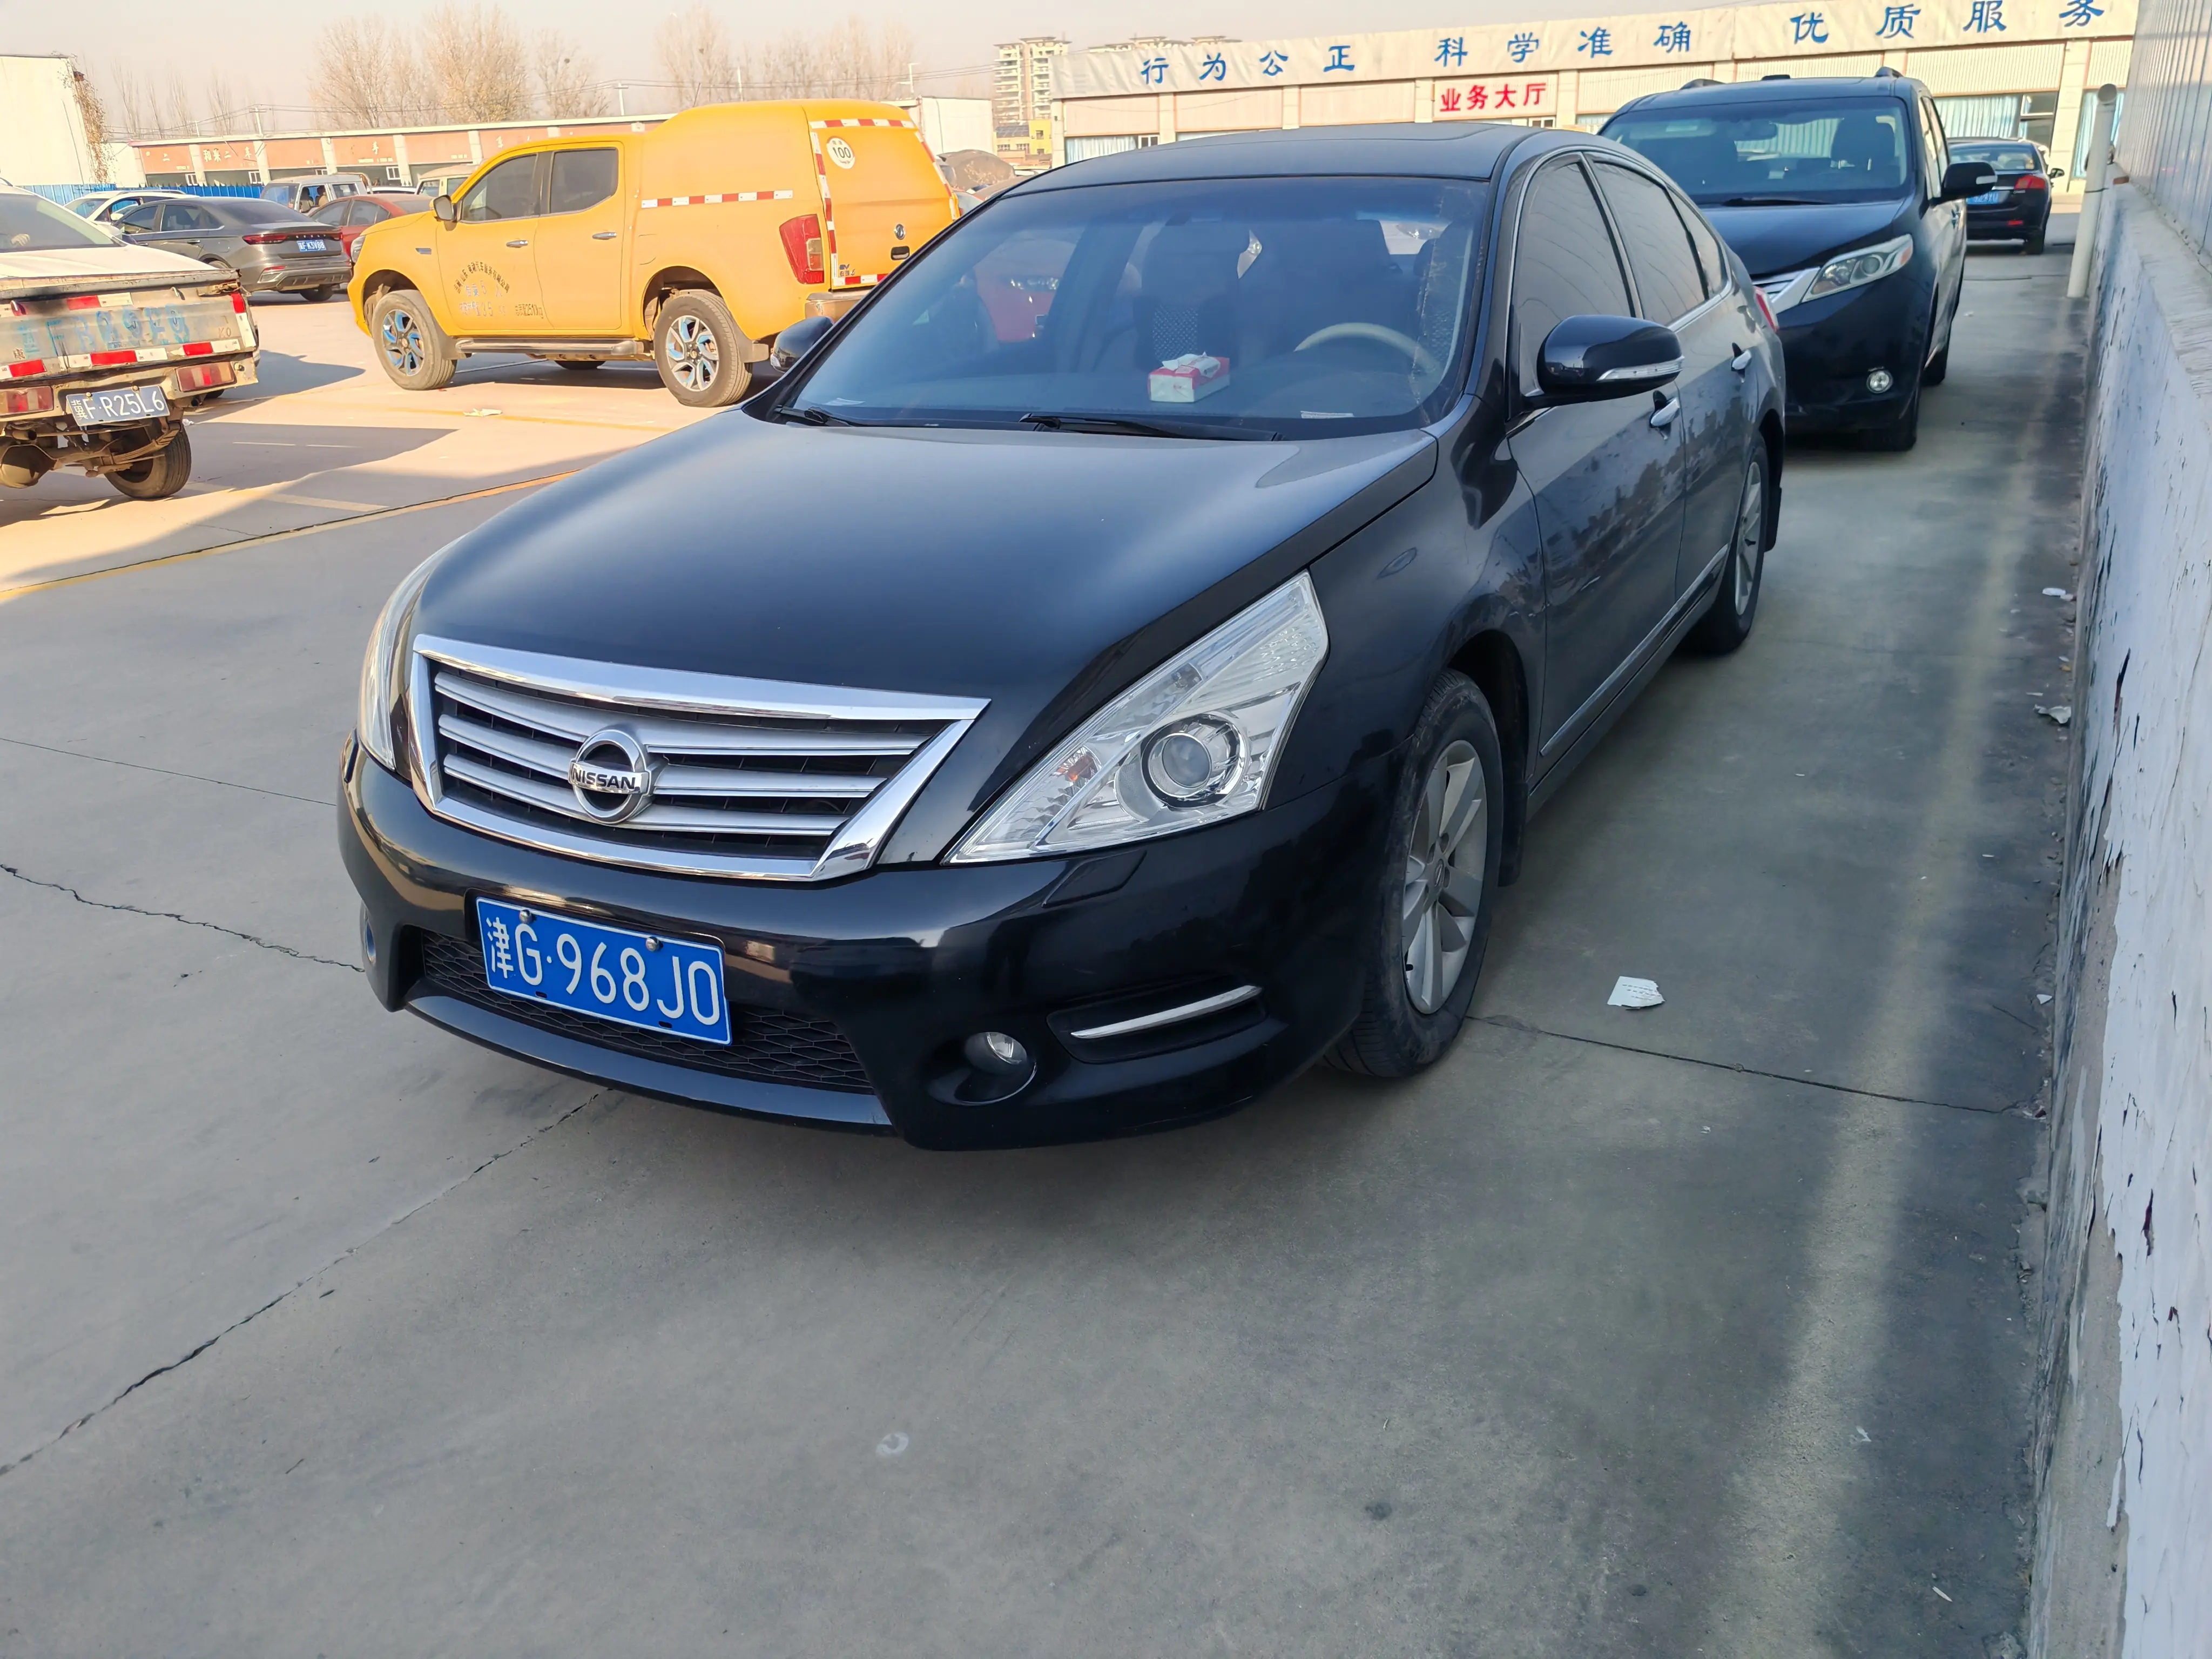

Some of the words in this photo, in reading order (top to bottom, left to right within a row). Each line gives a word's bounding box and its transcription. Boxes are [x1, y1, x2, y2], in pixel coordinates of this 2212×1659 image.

[1141, 45, 1355, 84] 行为公正
[1435, 22, 1690, 66] 科学准确
[1790, 0, 2103, 43] 优质服务
[1440, 83, 1546, 112] 业务大厅
[832, 147, 851, 158] 100
[71, 390, 165, 420] 冀F·R25L6
[572, 767, 636, 790] NISSAN
[487, 916, 720, 1026] 津G·968J0
